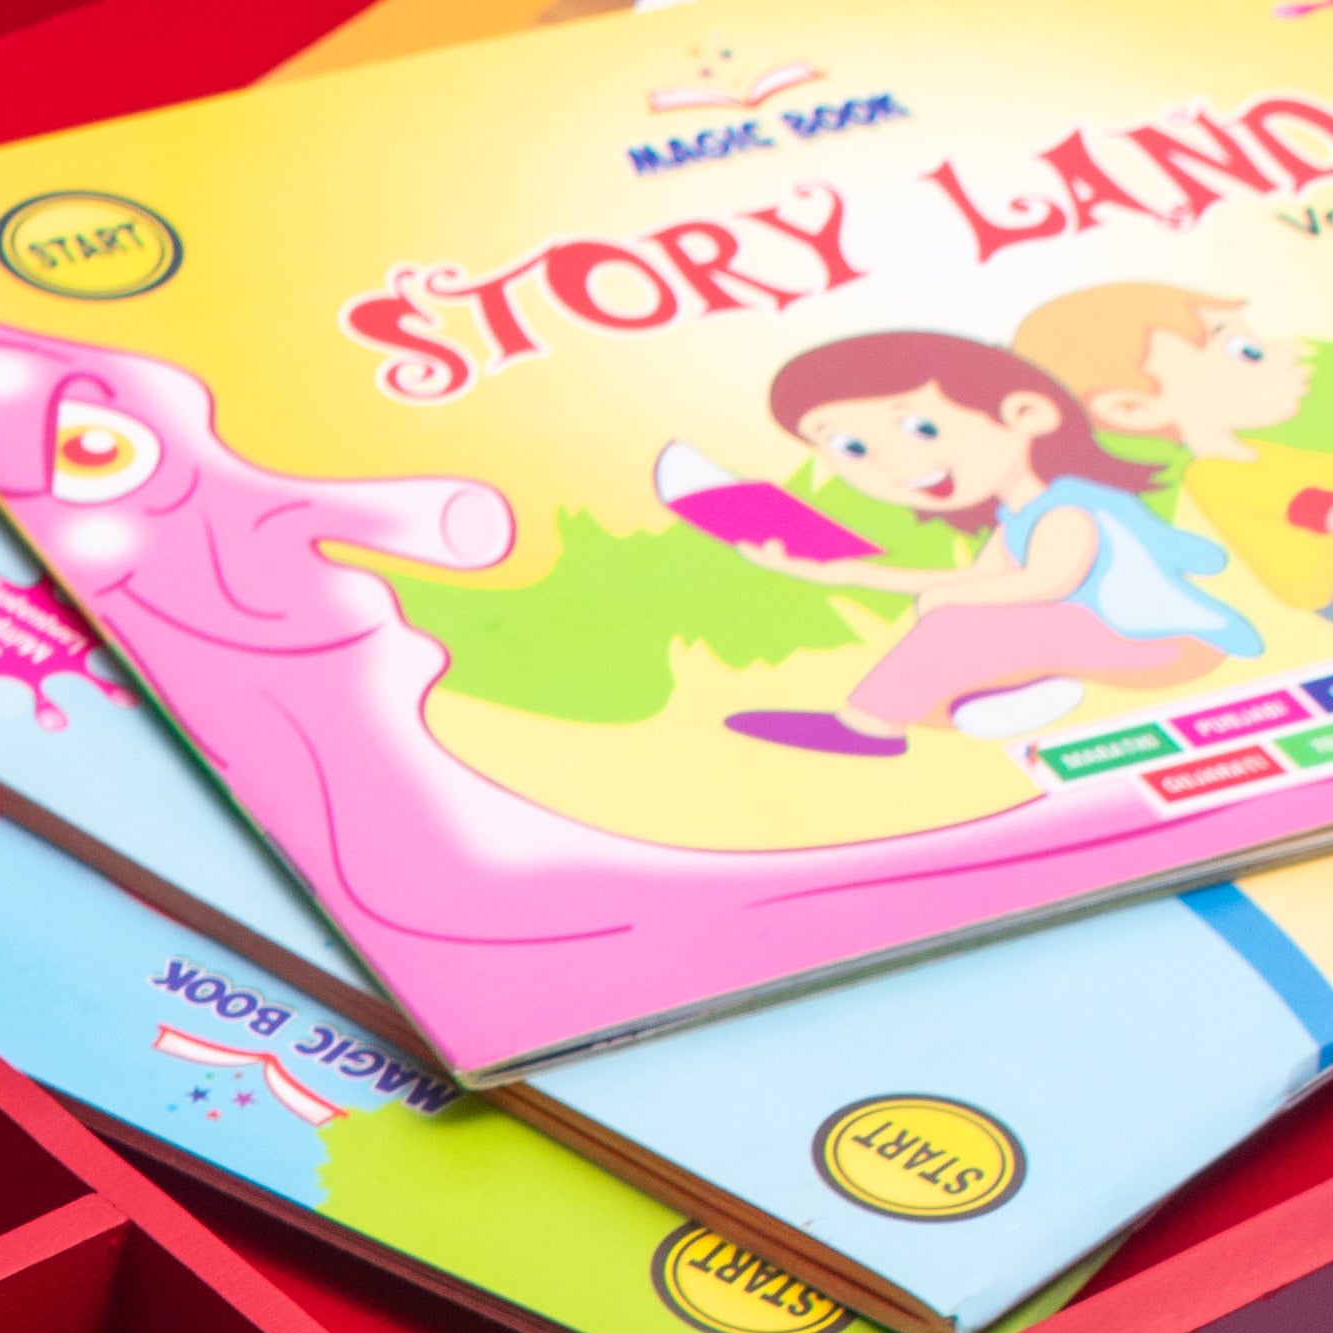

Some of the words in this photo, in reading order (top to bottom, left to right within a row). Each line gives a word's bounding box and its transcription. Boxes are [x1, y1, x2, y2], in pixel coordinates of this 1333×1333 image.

[628, 119, 775, 175] MAGIC
[782, 92, 911, 139] BOOK
[29, 222, 145, 269] START
[345, 180, 870, 400] STORY
[151, 959, 292, 1037] BOOK
[294, 1024, 457, 1114] MAGIC
[850, 1119, 985, 1195] START
[686, 1239, 833, 1318] START
